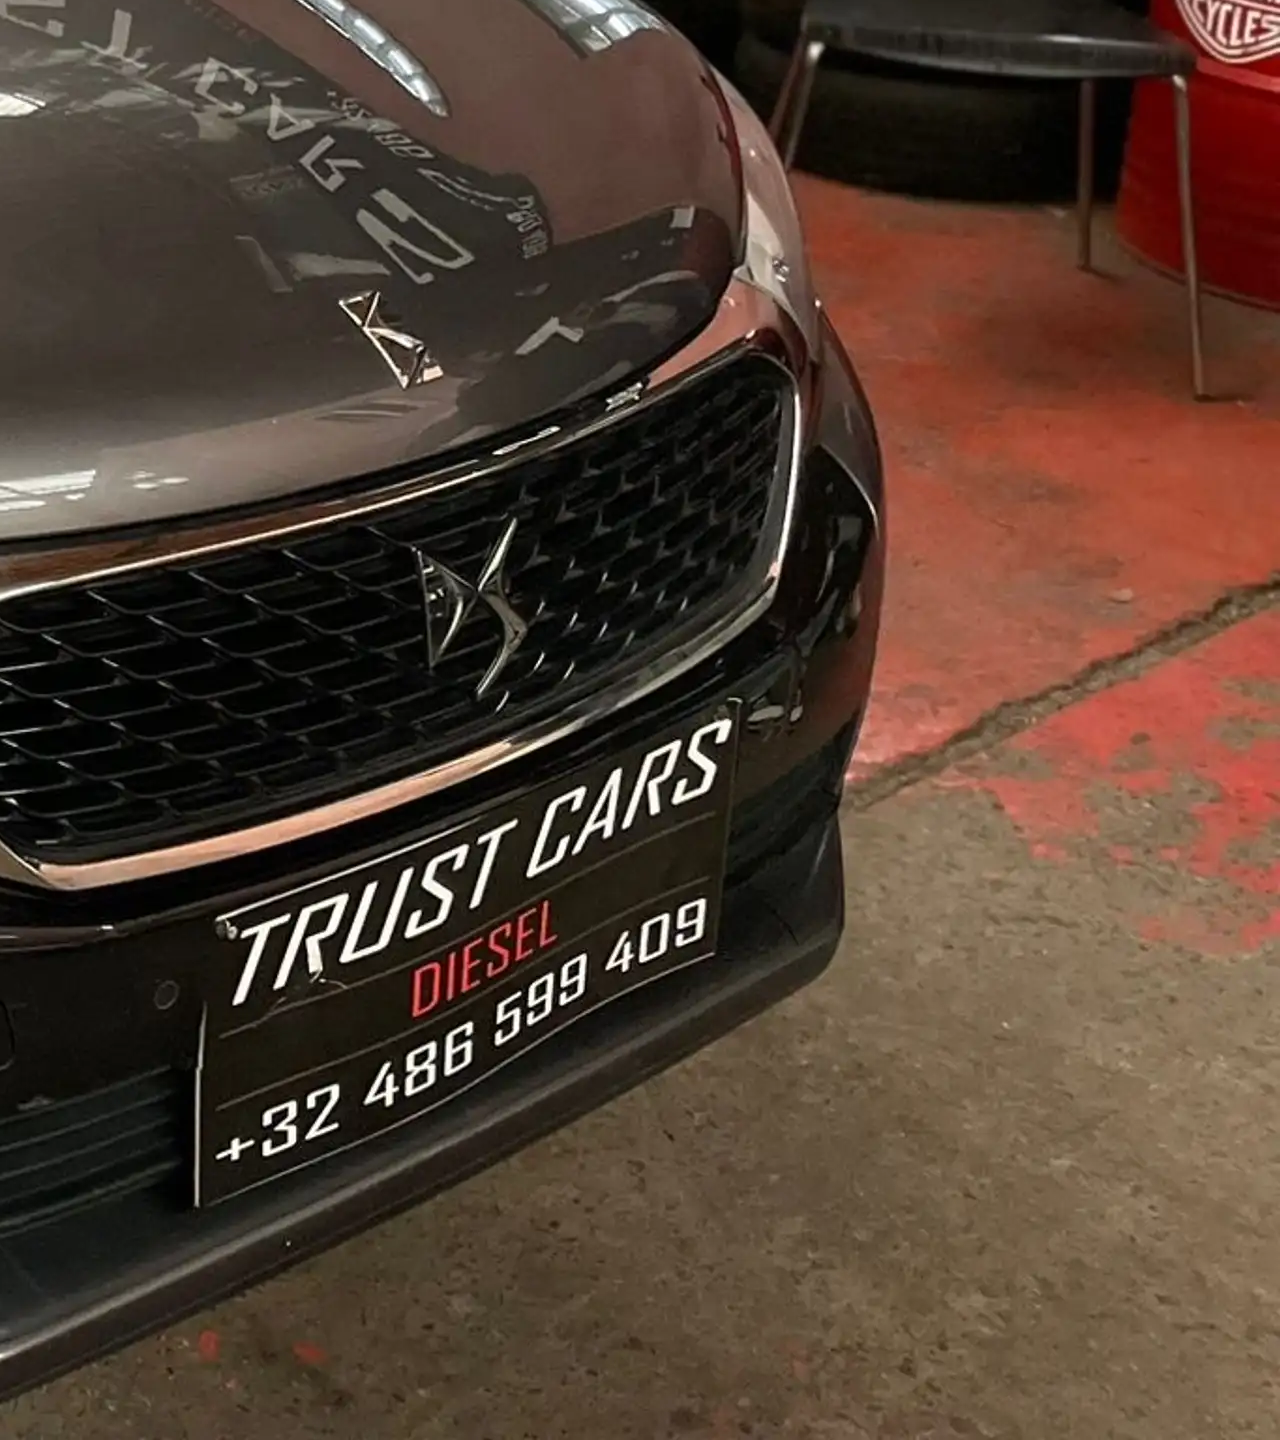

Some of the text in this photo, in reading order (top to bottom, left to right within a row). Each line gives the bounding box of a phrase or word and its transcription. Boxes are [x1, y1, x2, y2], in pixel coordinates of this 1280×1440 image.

[230, 717, 734, 1008] TRUST CARS
[410, 899, 559, 1019] DIESEL
[214, 896, 708, 1162] +32 486 599 409
